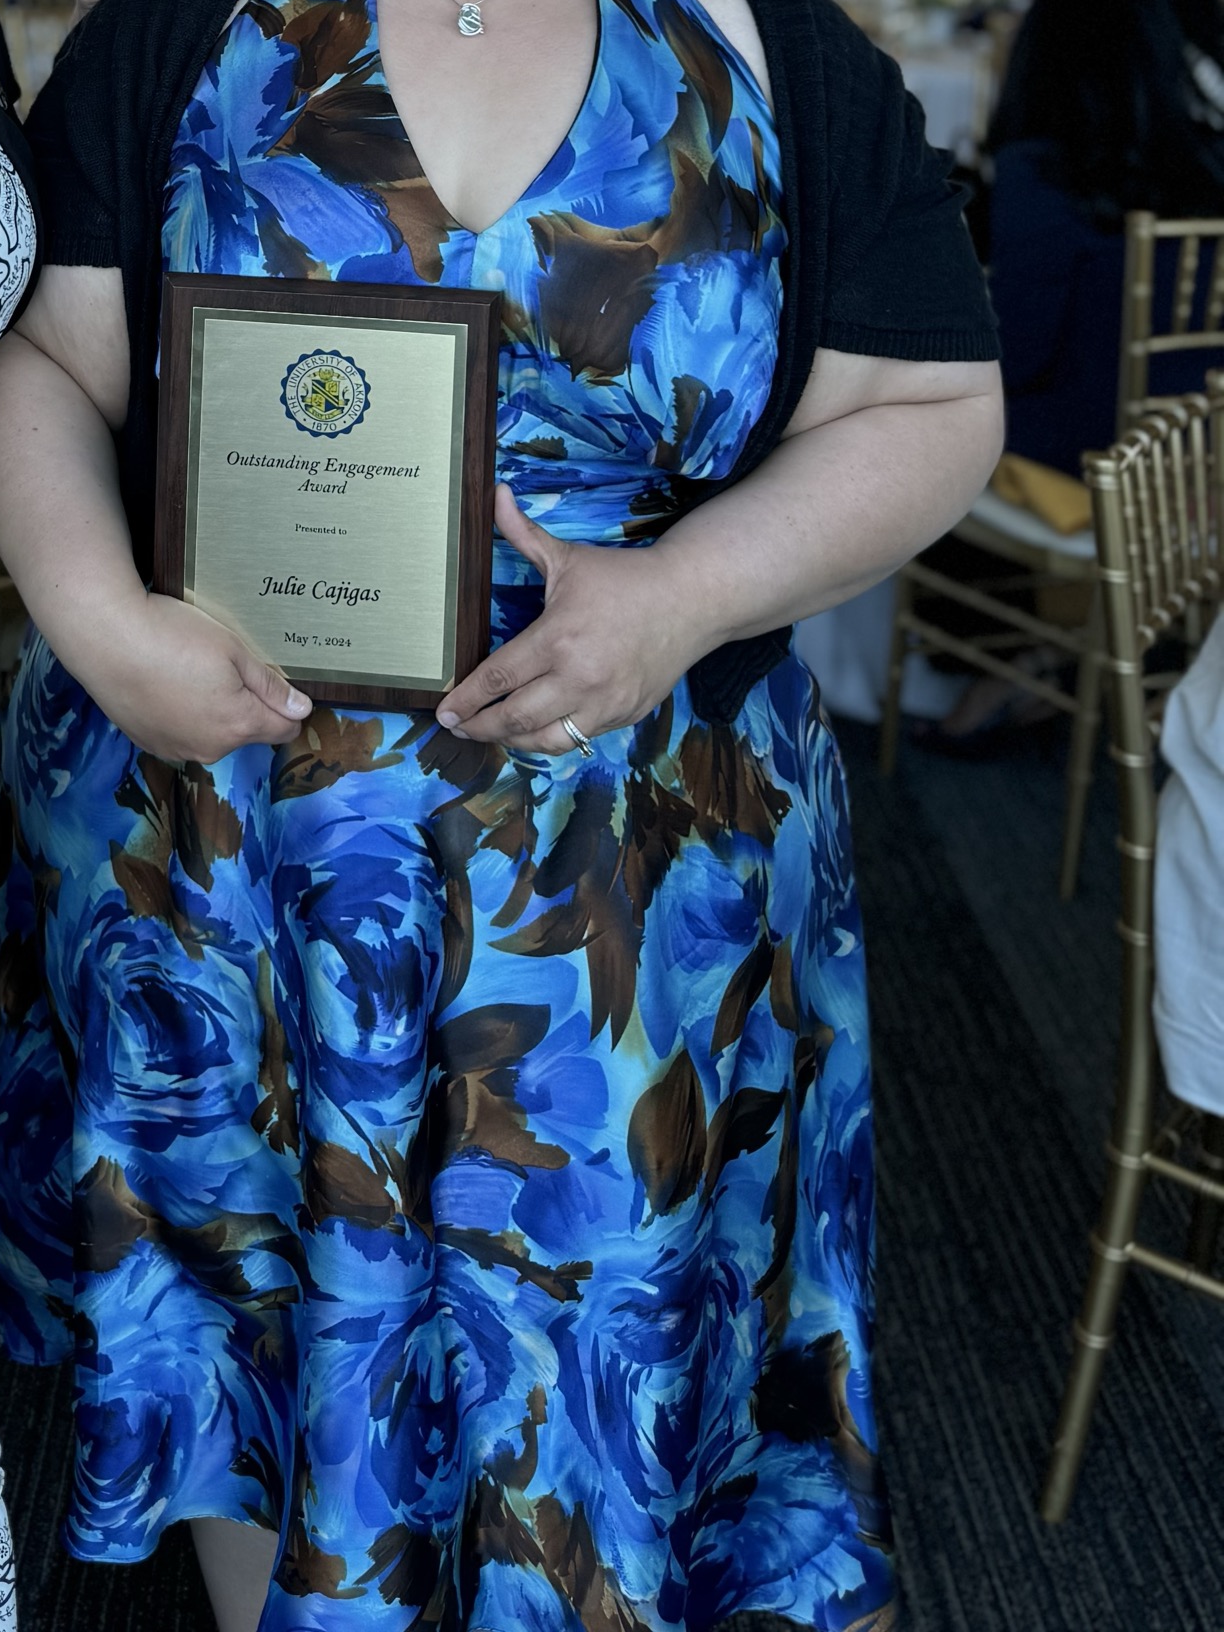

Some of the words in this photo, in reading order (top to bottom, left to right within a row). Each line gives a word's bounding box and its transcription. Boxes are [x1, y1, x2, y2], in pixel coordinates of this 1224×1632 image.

[289, 356, 342, 387] UNIVERSITY
[345, 366, 357, 377] OF
[288, 395, 300, 416] THE
[348, 383, 364, 420] AKRON
[312, 422, 337, 431] 1870
[226, 450, 321, 476] Outstanding
[323, 456, 421, 480] Engagement
[297, 478, 348, 495] Award
[294, 523, 336, 536] Presented
[338, 527, 348, 536] to
[258, 575, 307, 597] Julie
[311, 580, 382, 607] Cajigas
[284, 631, 309, 647] May
[312, 635, 322, 647] 7,
[324, 636, 352, 648] 2024
